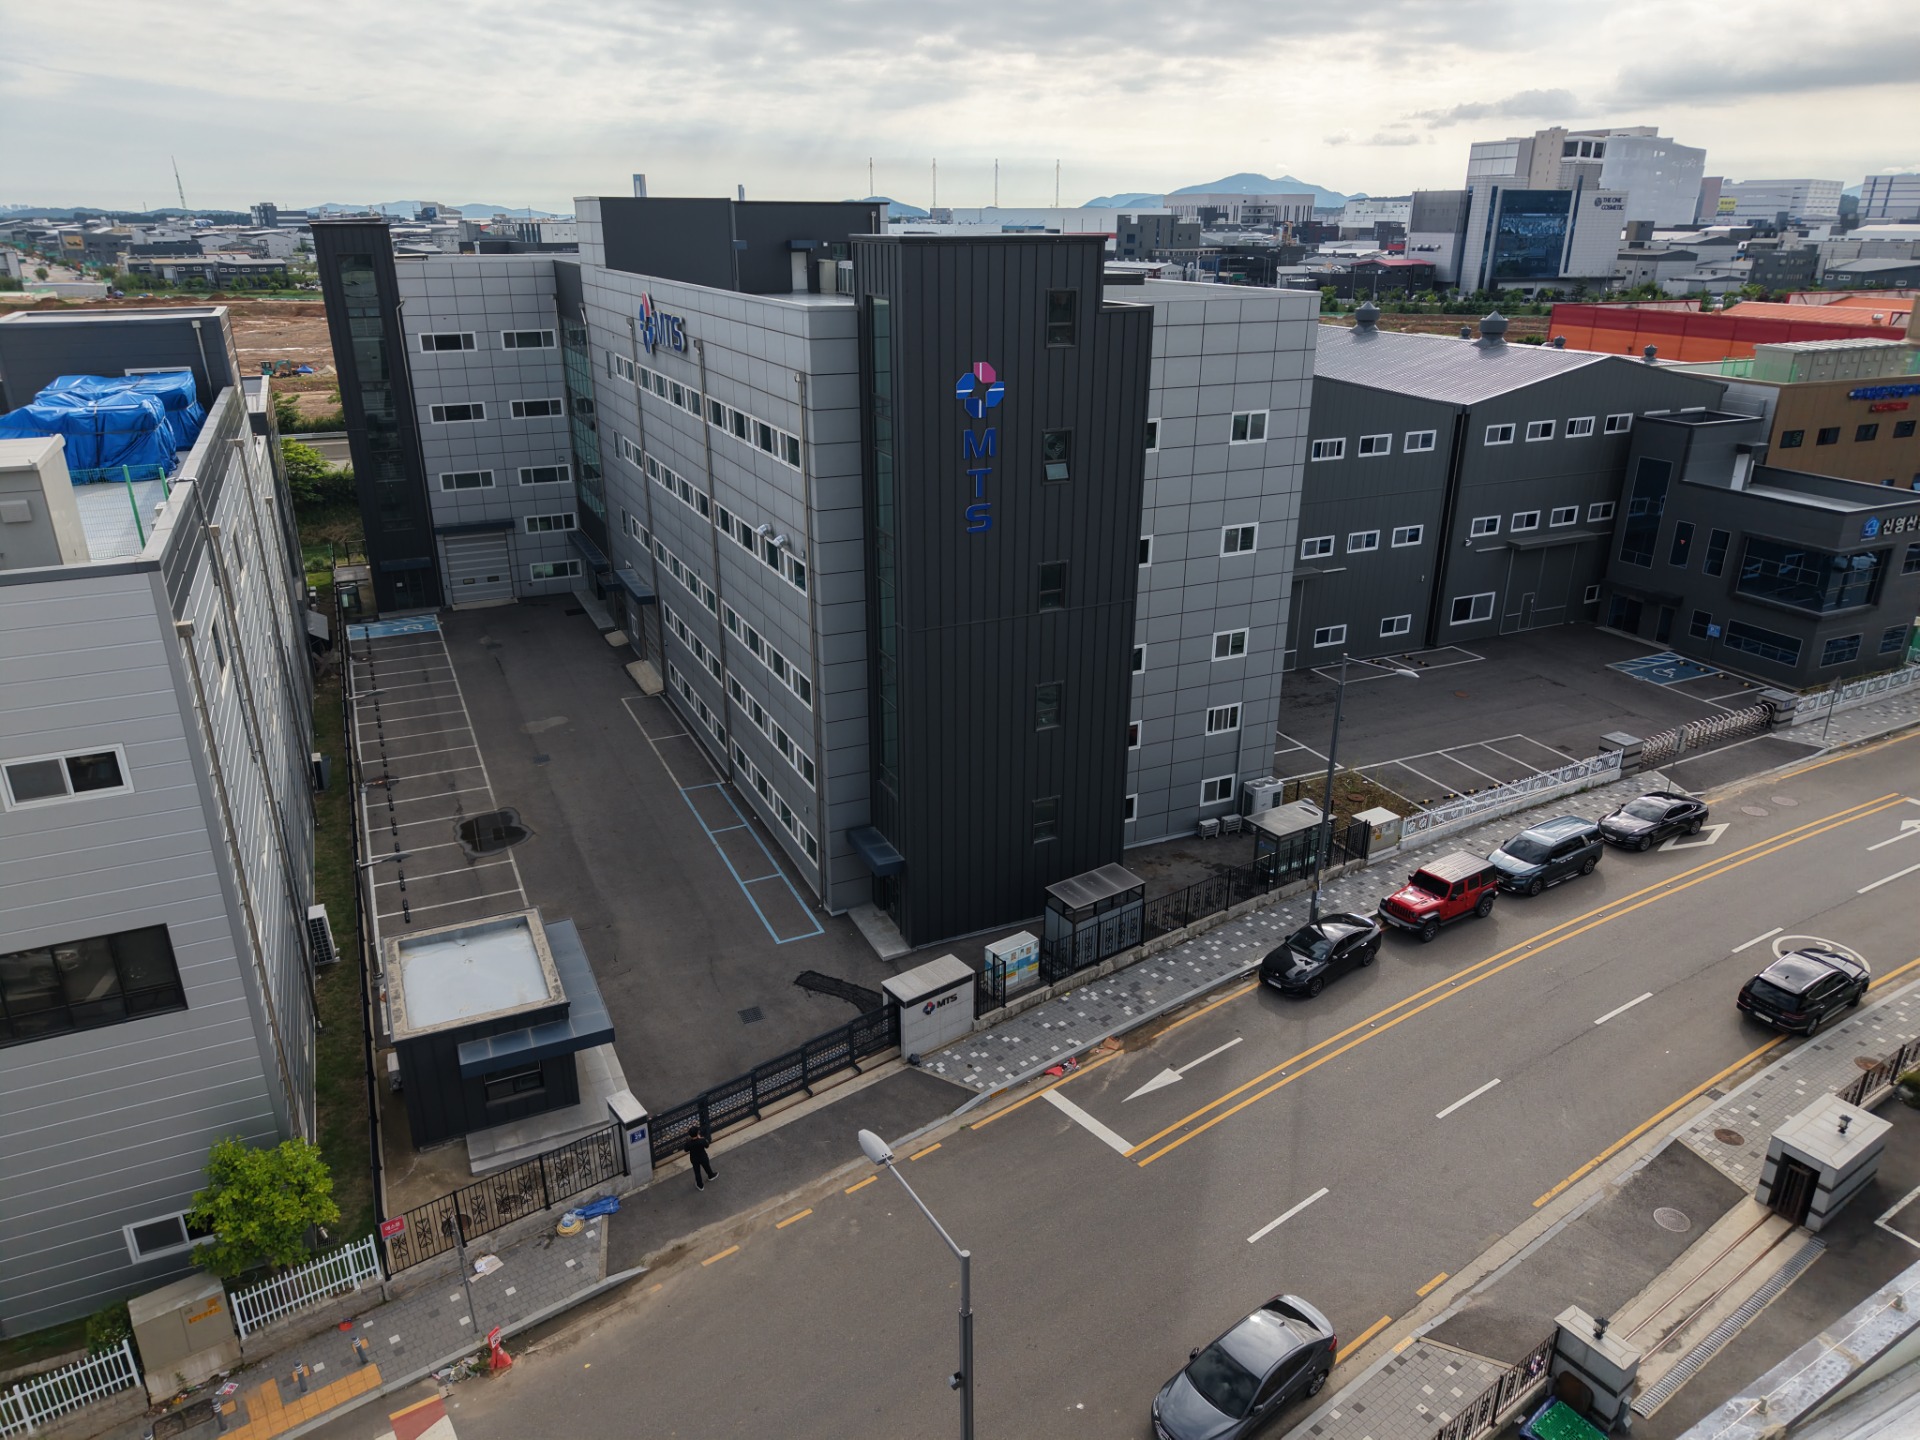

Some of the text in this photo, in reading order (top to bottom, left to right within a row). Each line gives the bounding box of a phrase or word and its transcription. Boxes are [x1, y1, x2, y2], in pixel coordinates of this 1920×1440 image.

[654, 311, 685, 352] MTS
[963, 428, 996, 533] MTS
[1883, 515, 1920, 535] 신영산
[936, 993, 958, 1008] MTS
